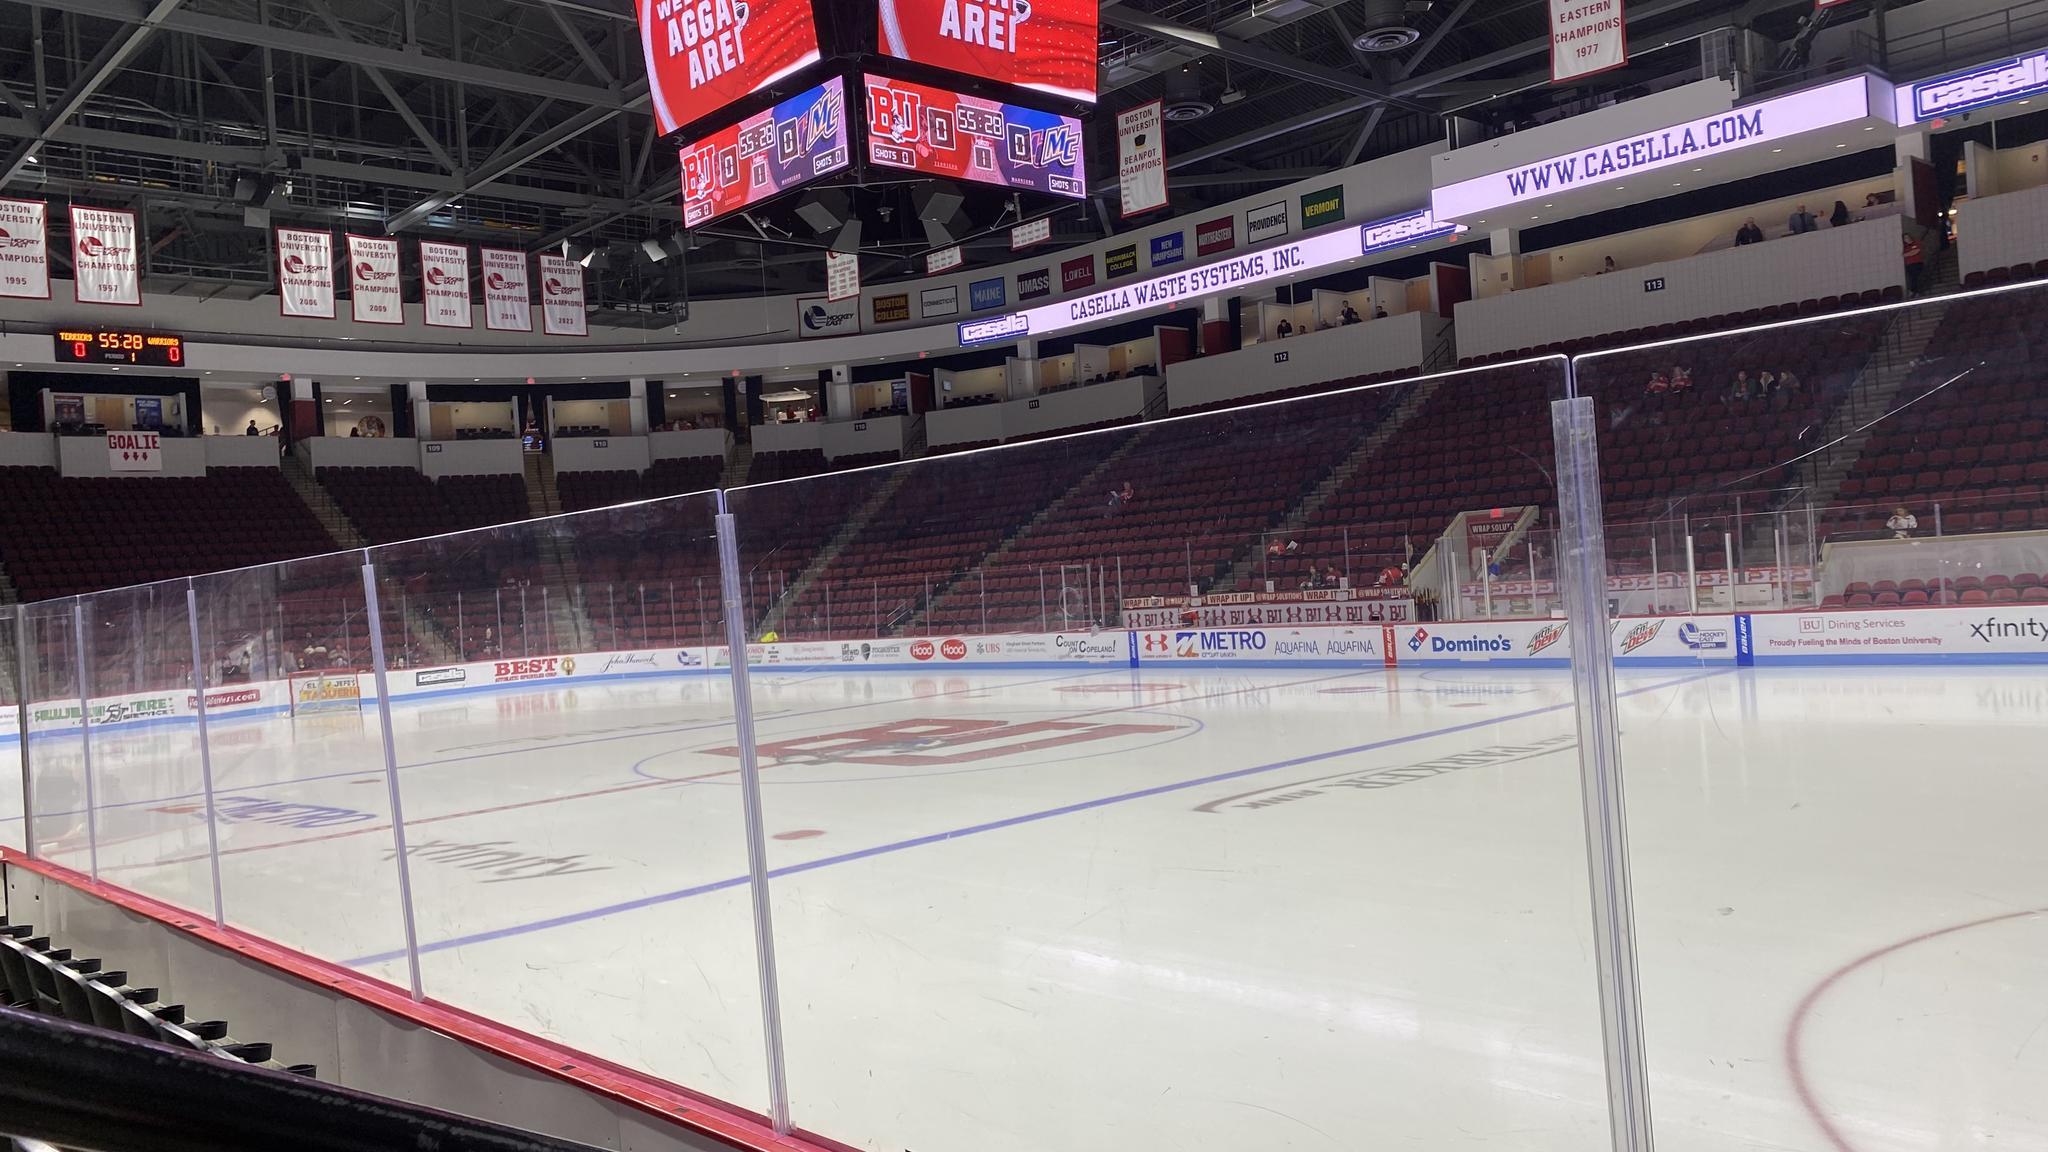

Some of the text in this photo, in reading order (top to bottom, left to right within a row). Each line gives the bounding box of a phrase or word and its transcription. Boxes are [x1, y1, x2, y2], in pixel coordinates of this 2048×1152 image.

[1560, 0, 1611, 23] EASTERN
[1555, 17, 1620, 44] CHAMPIONS
[1576, 44, 1599, 58] 1977
[805, 86, 843, 152] MC
[868, 85, 921, 143] BU
[1125, 108, 1153, 125] BOSTON
[936, 118, 947, 141] 0
[958, 110, 1001, 135] 55:28
[1119, 116, 1161, 137] UNIVERSITY
[740, 123, 774, 155] 55:28
[783, 129, 793, 153] 0
[1015, 133, 1025, 155] 0
[1041, 124, 1080, 166] MC
[835, 150, 842, 164] 0
[875, 148, 909, 164] SHOTS 0
[1124, 147, 1157, 166] BEANPOT
[1507, 109, 1764, 196] WWW.CASELLA.COM
[724, 154, 734, 178] 0
[815, 155, 833, 171] SHOTS
[1121, 157, 1162, 178] CHAMPIONS
[683, 144, 715, 202] BU
[1051, 178, 1079, 193] SHOTS 0
[1304, 198, 1340, 217] VERMONT
[83, 212, 122, 223] BOSTON
[1249, 213, 1286, 233] PROVIDENCE
[75, 222, 133, 233] UNIVERSITY
[287, 233, 320, 243] BOSTON
[357, 241, 388, 250] BOSTON
[280, 242, 328, 253] UNIVERSITY
[352, 250, 397, 260] UNIVERSITY
[429, 246, 459, 256] BOSTON
[1152, 247, 1183, 263] HAMPSHIRE
[423, 255, 466, 265] UNIVERSITY
[490, 253, 518, 262] BOSTON
[548, 258, 574, 267] BOSTON
[78, 260, 136, 272] CHAMPIONS
[484, 261, 525, 271] UNIVERSITY
[542, 267, 581, 276] UNIVERSITY
[1110, 259, 1134, 273] COLLEGE
[5, 276, 27, 285] 1995
[1064, 267, 1092, 282] LOWELL
[98, 284, 118, 292] 1997
[283, 278, 331, 288] CHAMPIONS
[354, 284, 399, 294] CHAMPIONS
[1018, 275, 1049, 295] UMASS
[1071, 246, 1305, 320] CASELLA WASTE SYSTEMS, INC.
[1646, 280, 1663, 290] 113
[426, 288, 468, 299] CHAMPIONS
[487, 293, 528, 303] CHAMPIONS
[974, 287, 1001, 303] MAINE
[545, 298, 583, 308] CHAMPIONS
[875, 298, 906, 310] BOSTON
[440, 309, 457, 317] 2015
[826, 312, 855, 321] HOCKEY
[875, 308, 909, 321] COLLEGE
[825, 319, 842, 327] EAST
[963, 313, 1028, 341] casella
[99, 333, 143, 349] 55:28
[75, 342, 86, 357] 0
[169, 347, 179, 362] 0
[1275, 353, 1287, 361] 112
[108, 434, 160, 450] GOALIE
[1472, 525, 1490, 533] WRAP
[1210, 595, 1226, 603] WRAP
[1240, 593, 1252, 602] UP!
[1306, 591, 1329, 600] WRAP
[1123, 600, 1141, 608] WRAP
[1144, 613, 1158, 627] BU
[1230, 610, 1244, 625] BU
[1266, 609, 1282, 624] BU
[1306, 608, 1321, 622] BU
[1346, 606, 1363, 622] BU
[1390, 605, 1407, 621] BU
[1803, 618, 1905, 632] BU Dining Services
[1970, 617, 2048, 643] xfinity
[1201, 631, 1266, 650] METRO
[1275, 640, 1320, 655] AQUAFINA
[1327, 640, 1375, 655] AQUAFINA
[1431, 634, 1511, 653] Domino's
[1769, 636, 1942, 649] Proudly Fueling the Minds of Boston University
[912, 645, 933, 656] Hood
[944, 644, 964, 656] Hood
[985, 643, 1000, 654] UBS
[494, 658, 557, 677] BEST
